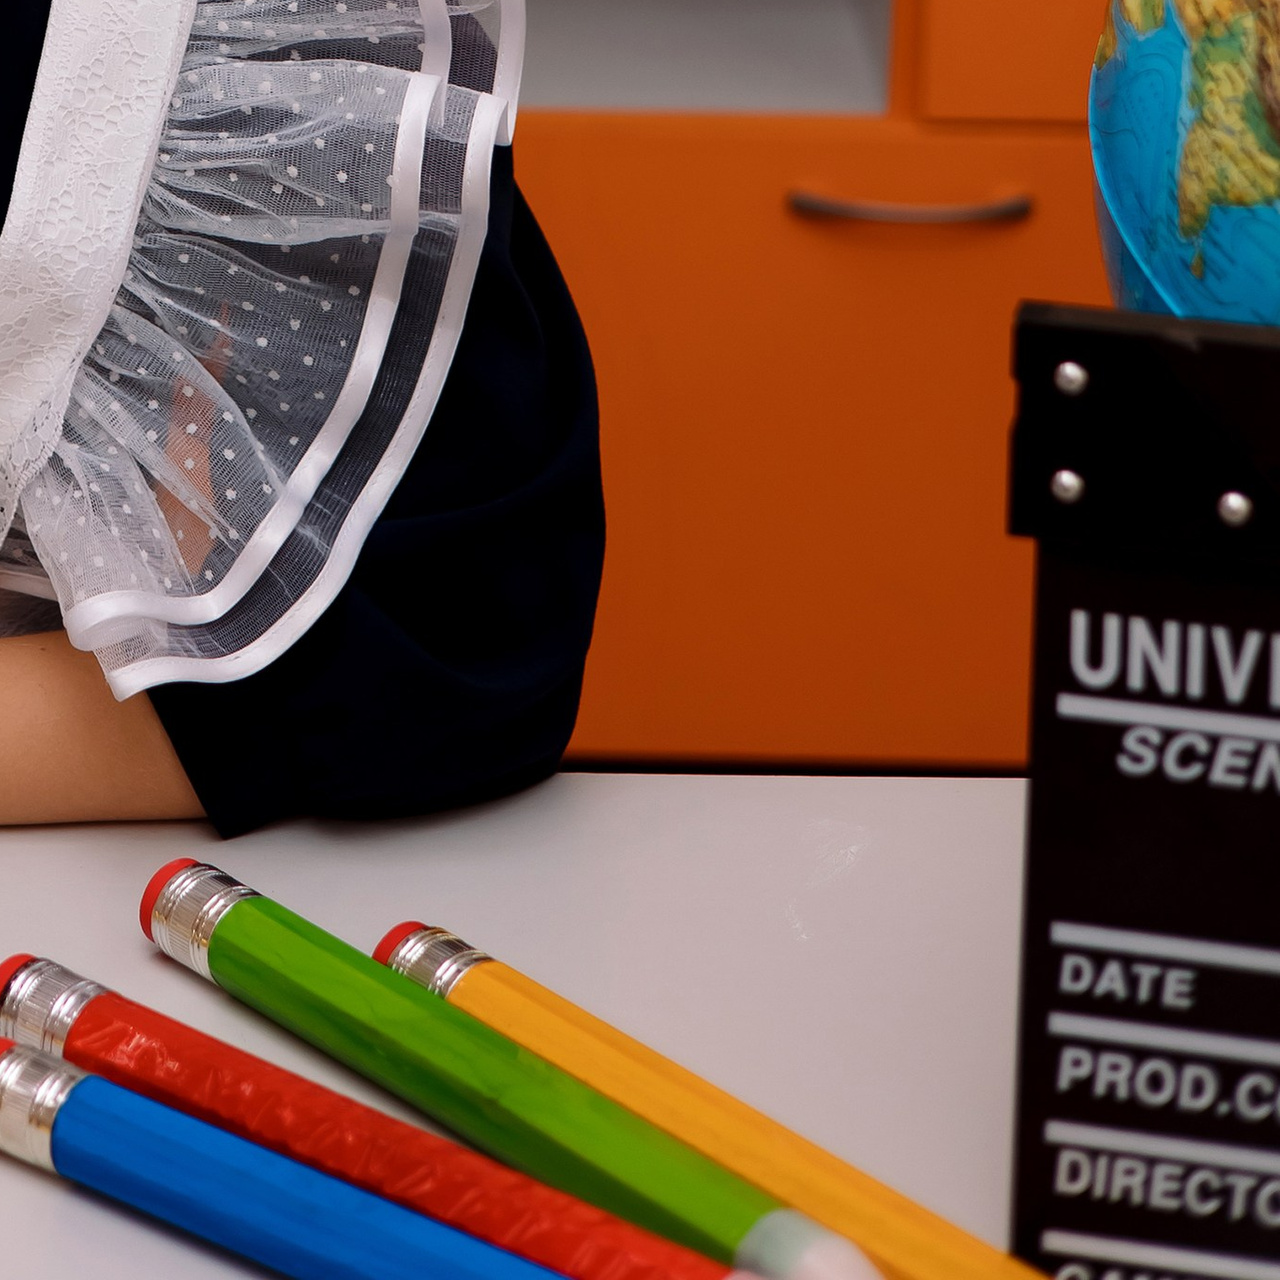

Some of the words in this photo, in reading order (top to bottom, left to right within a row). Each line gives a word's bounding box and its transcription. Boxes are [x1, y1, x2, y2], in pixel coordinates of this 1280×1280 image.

[1069, 607, 1280, 710] UNIV
[1059, 954, 1196, 1009] DATE
[1056, 1045, 1280, 1122] PROD.C
